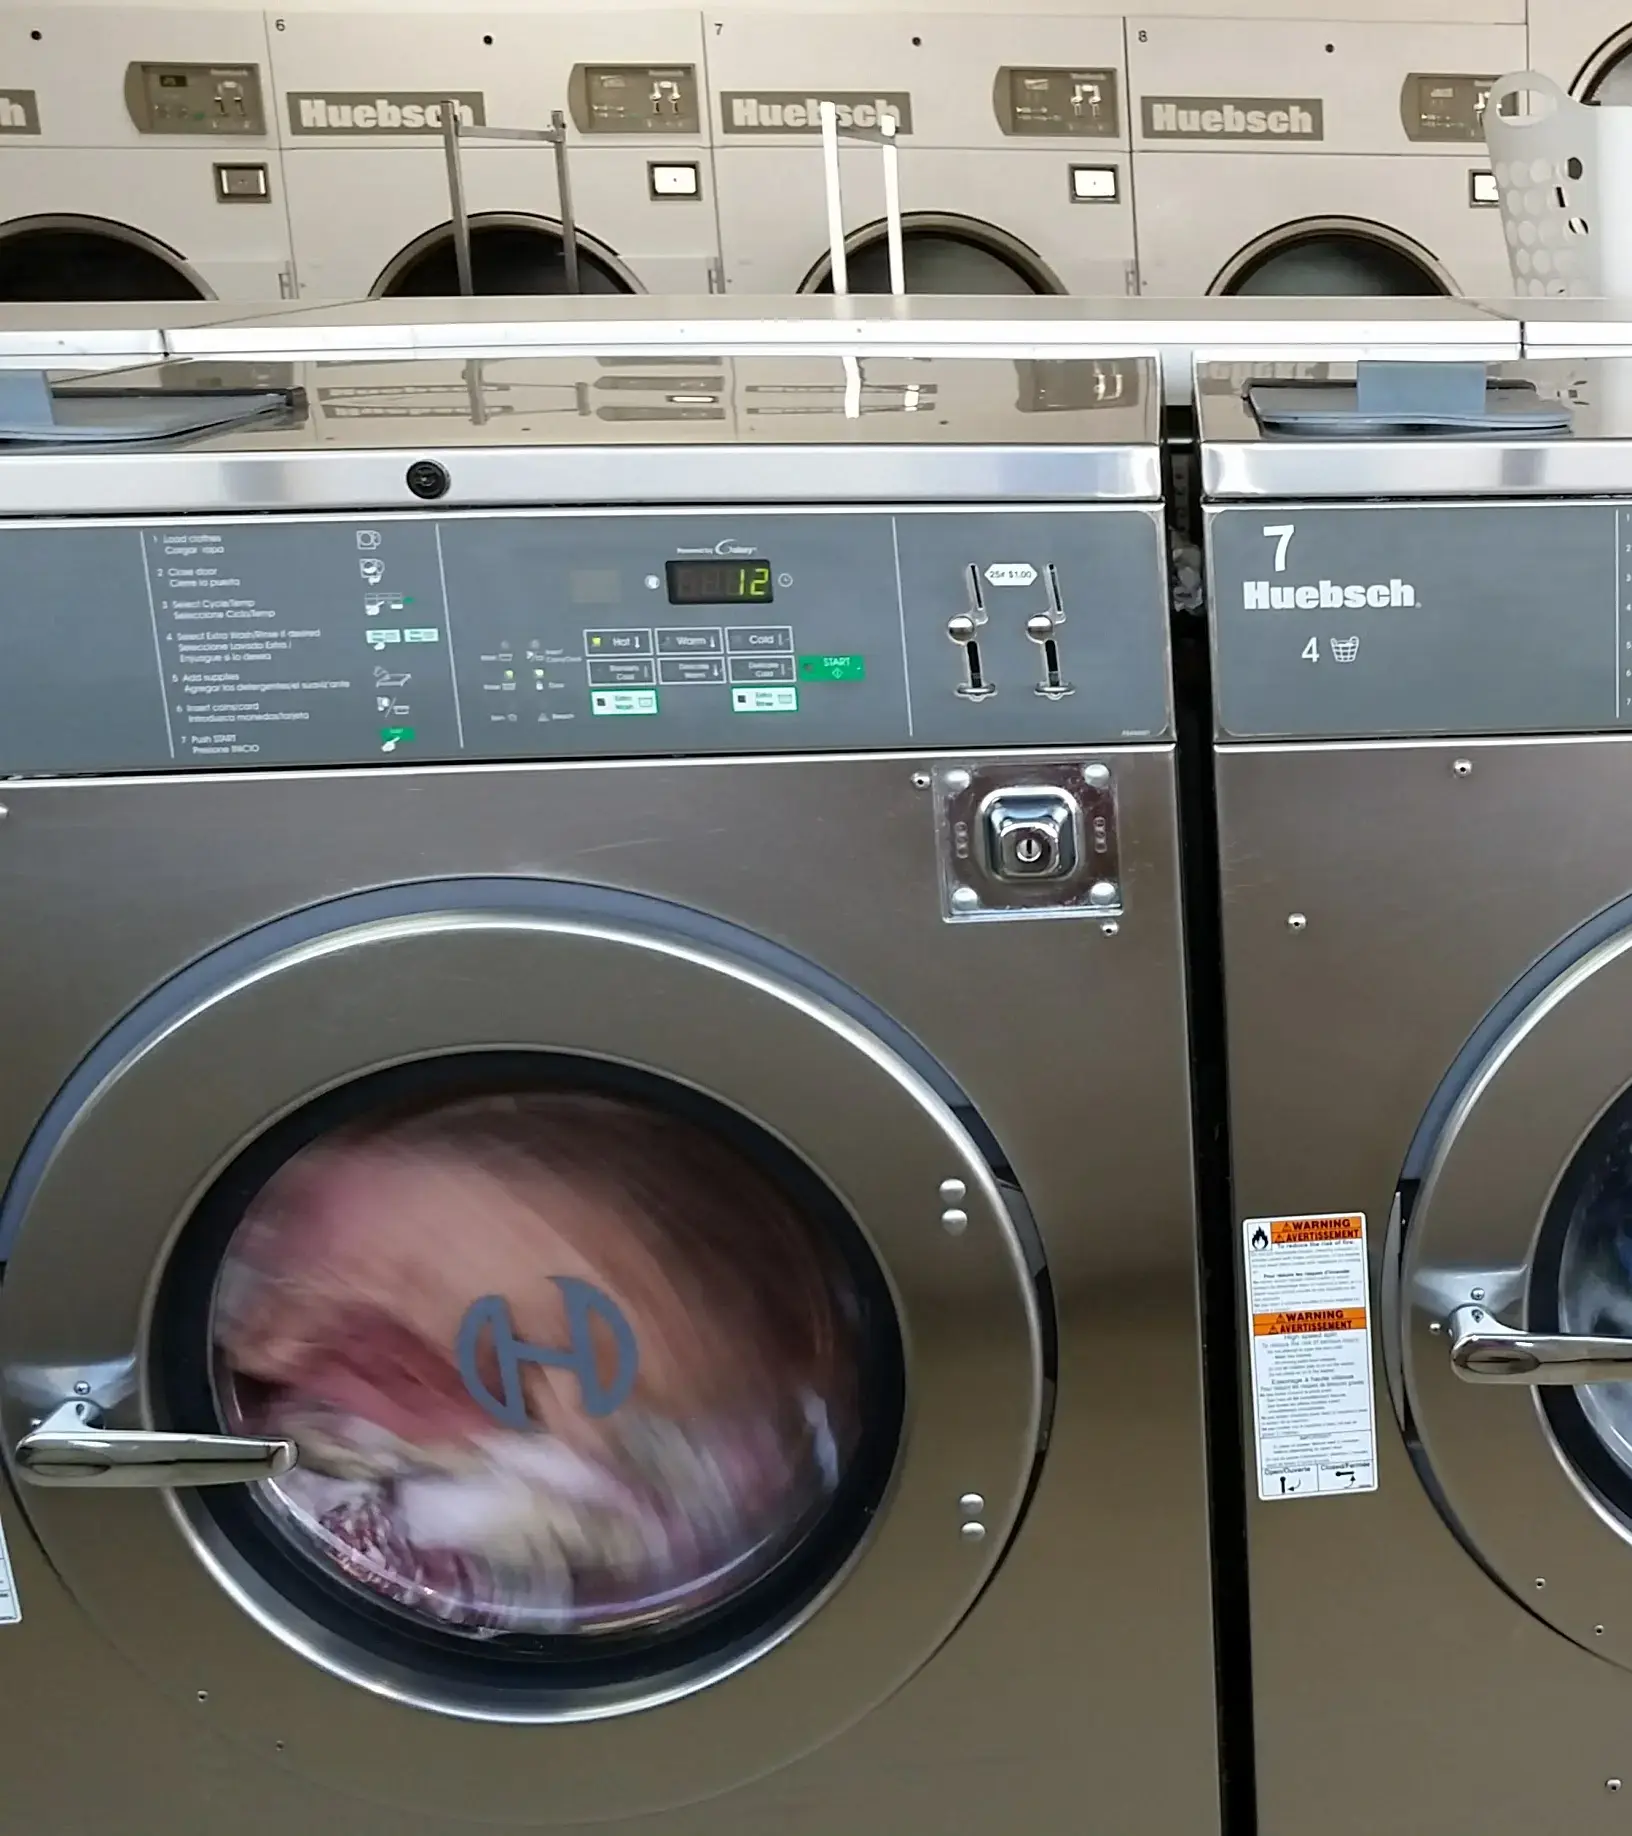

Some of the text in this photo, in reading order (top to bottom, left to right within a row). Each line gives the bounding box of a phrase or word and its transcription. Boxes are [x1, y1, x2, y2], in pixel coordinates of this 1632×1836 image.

[275, 18, 286, 32] 6
[714, 22, 723, 36] 7
[1138, 29, 1148, 43] 8
[300, 99, 474, 128] Huebsch
[1152, 104, 1313, 134] Huebsch
[1263, 524, 1295, 572] 7
[738, 568, 769, 596] 12
[1243, 579, 1416, 611] Huebsch
[612, 636, 631, 647] Hot
[749, 634, 774, 645] Cold
[1301, 637, 1320, 663] 4
[823, 657, 851, 668] START
[1291, 1218, 1350, 1230] WARNING
[1286, 1229, 1359, 1242] AVERTISSEMENT
[1286, 1309, 1344, 1321] WARNING
[1280, 1320, 1353, 1334] AVERTISSEMENT
